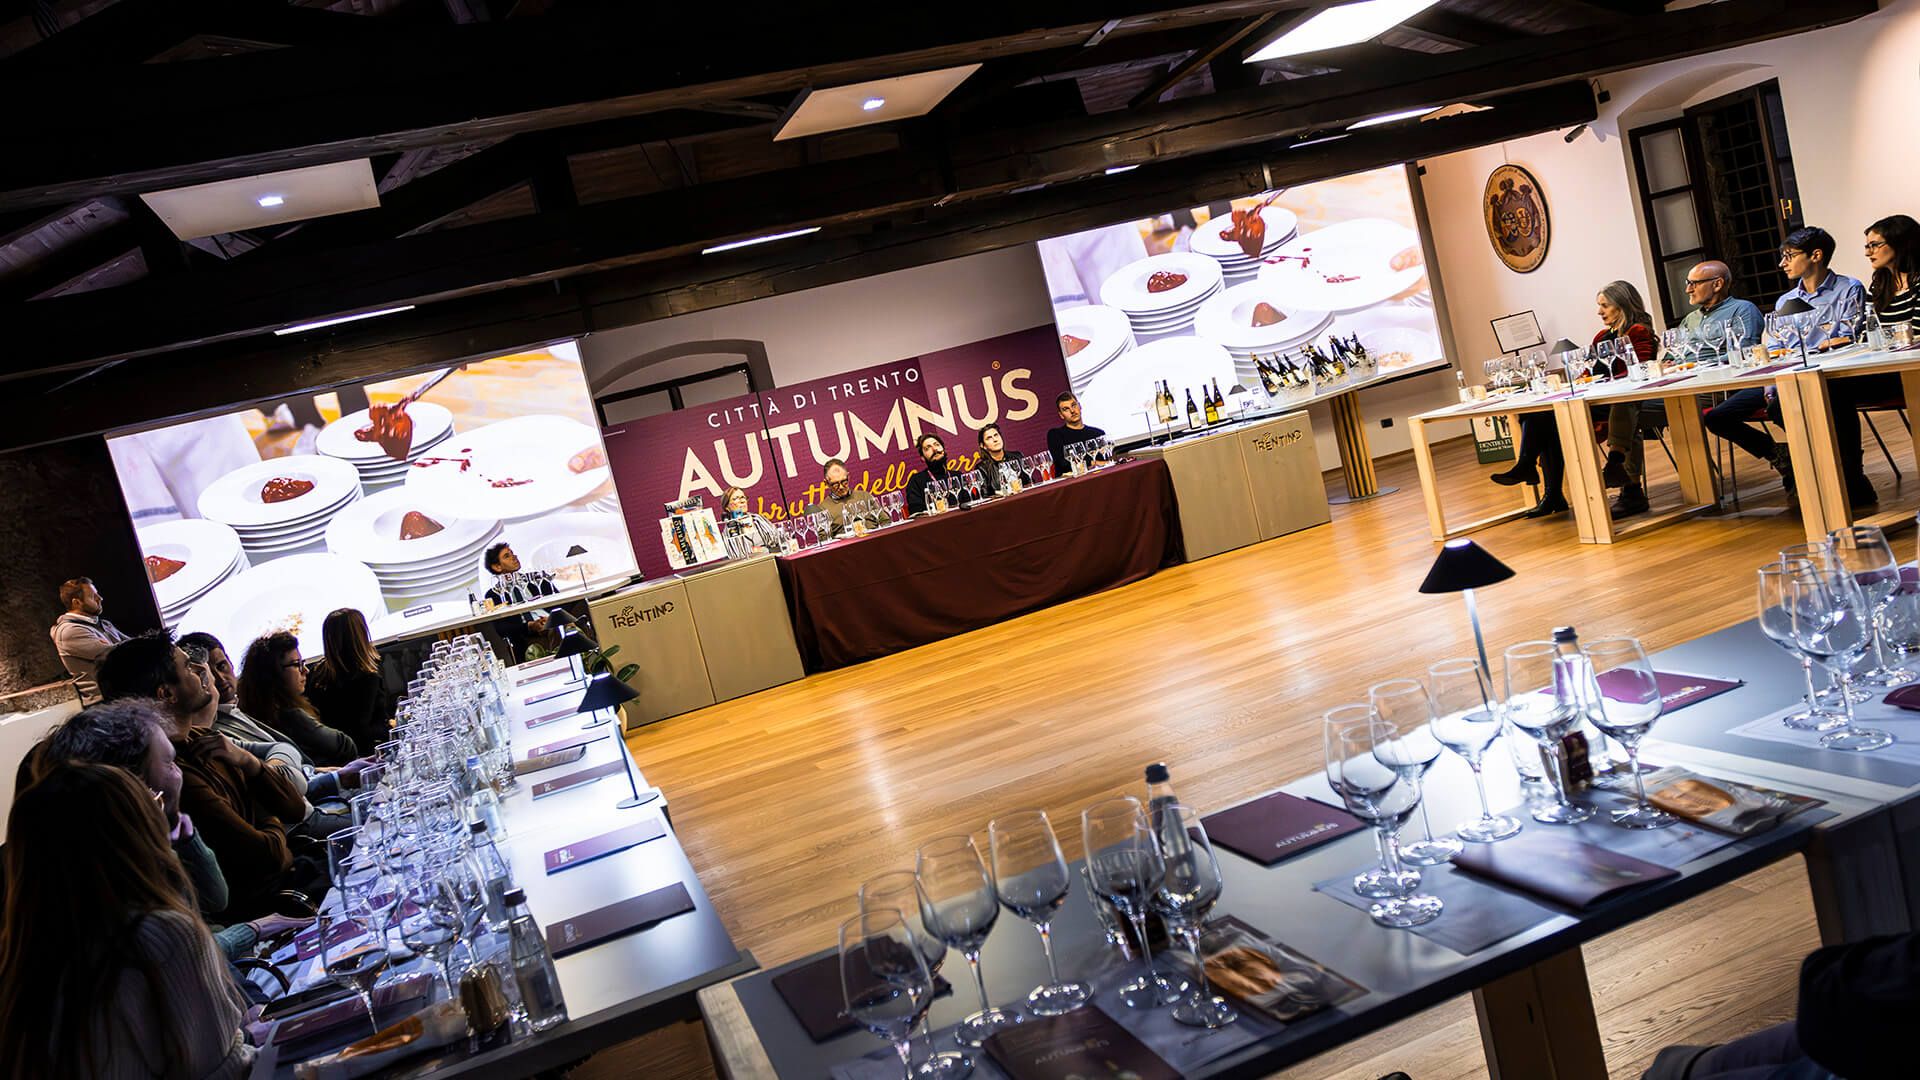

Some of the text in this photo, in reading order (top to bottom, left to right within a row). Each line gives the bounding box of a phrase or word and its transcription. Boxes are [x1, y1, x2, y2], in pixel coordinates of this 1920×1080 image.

[707, 368, 920, 428] CITTÀ DI TRENTO
[678, 368, 1040, 502] AUTUMNUS
[1252, 429, 1303, 452] TRENTINO
[608, 601, 675, 629] TRENTINO
